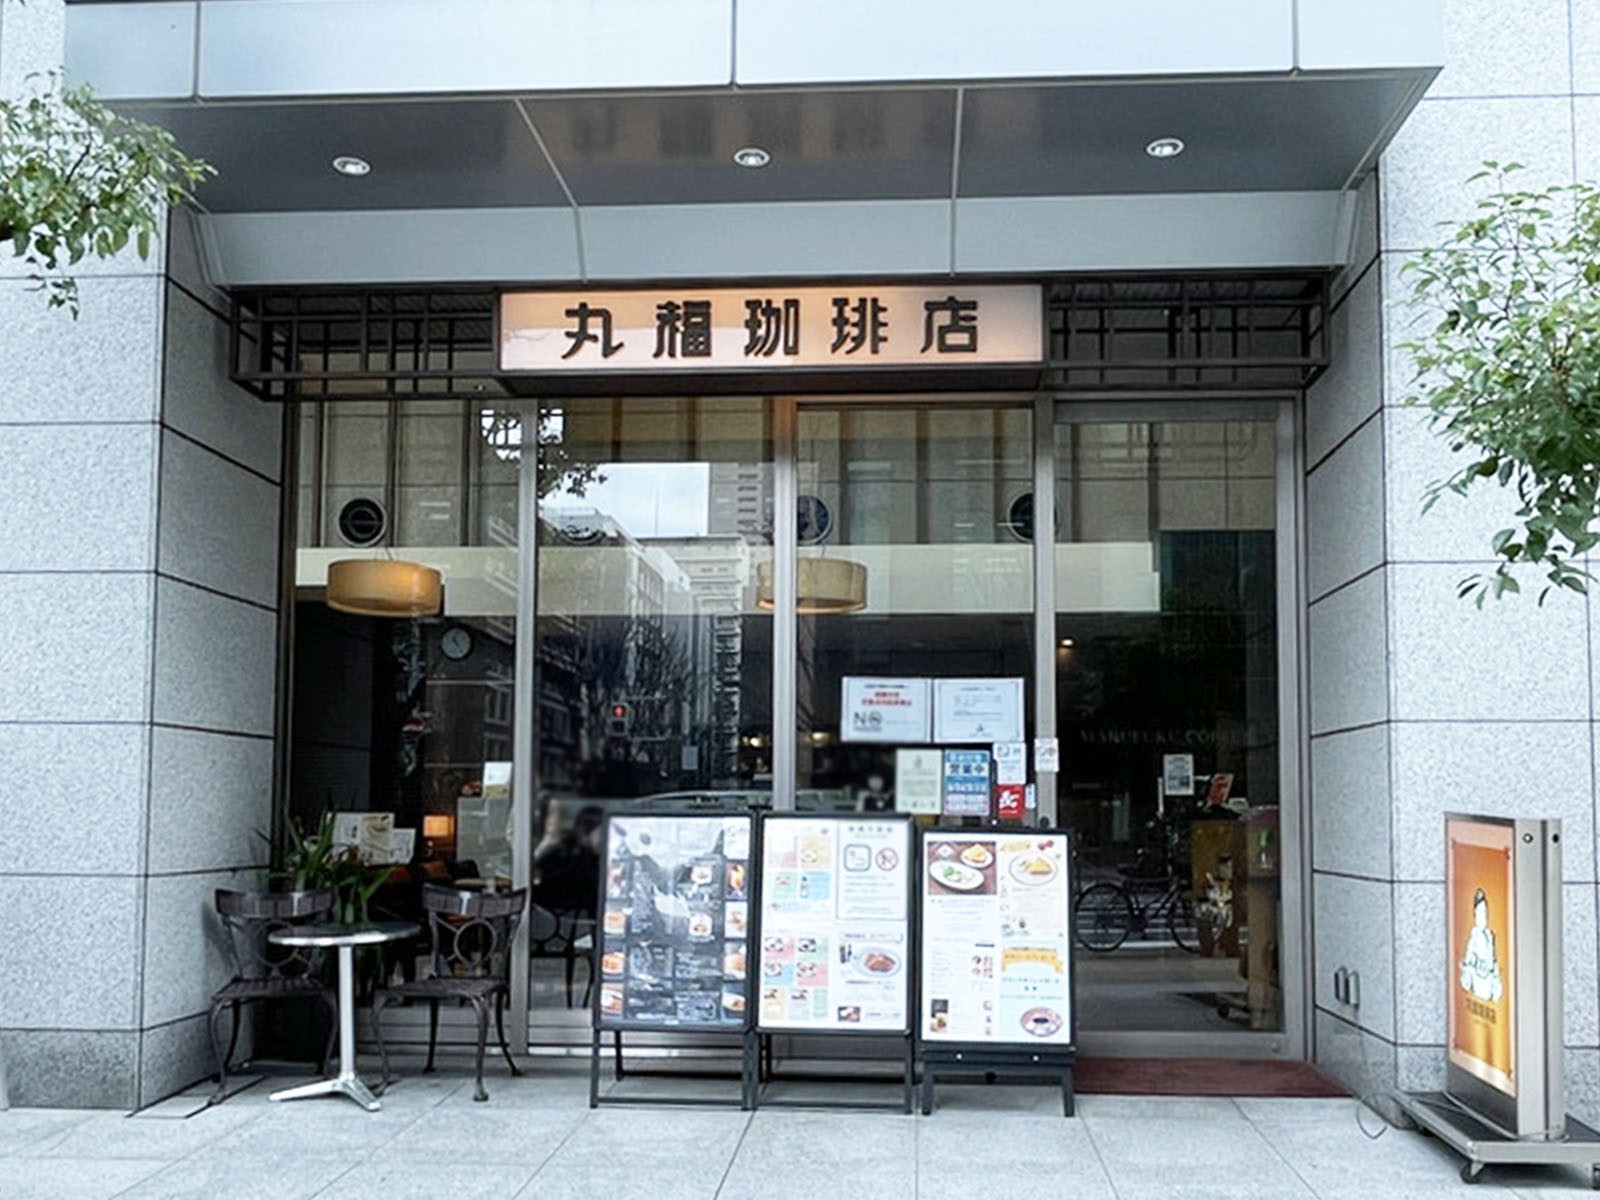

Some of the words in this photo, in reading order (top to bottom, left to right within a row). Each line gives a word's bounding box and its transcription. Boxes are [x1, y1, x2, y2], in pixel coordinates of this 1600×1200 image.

[561, 296, 979, 360] 丸福珈琲店
